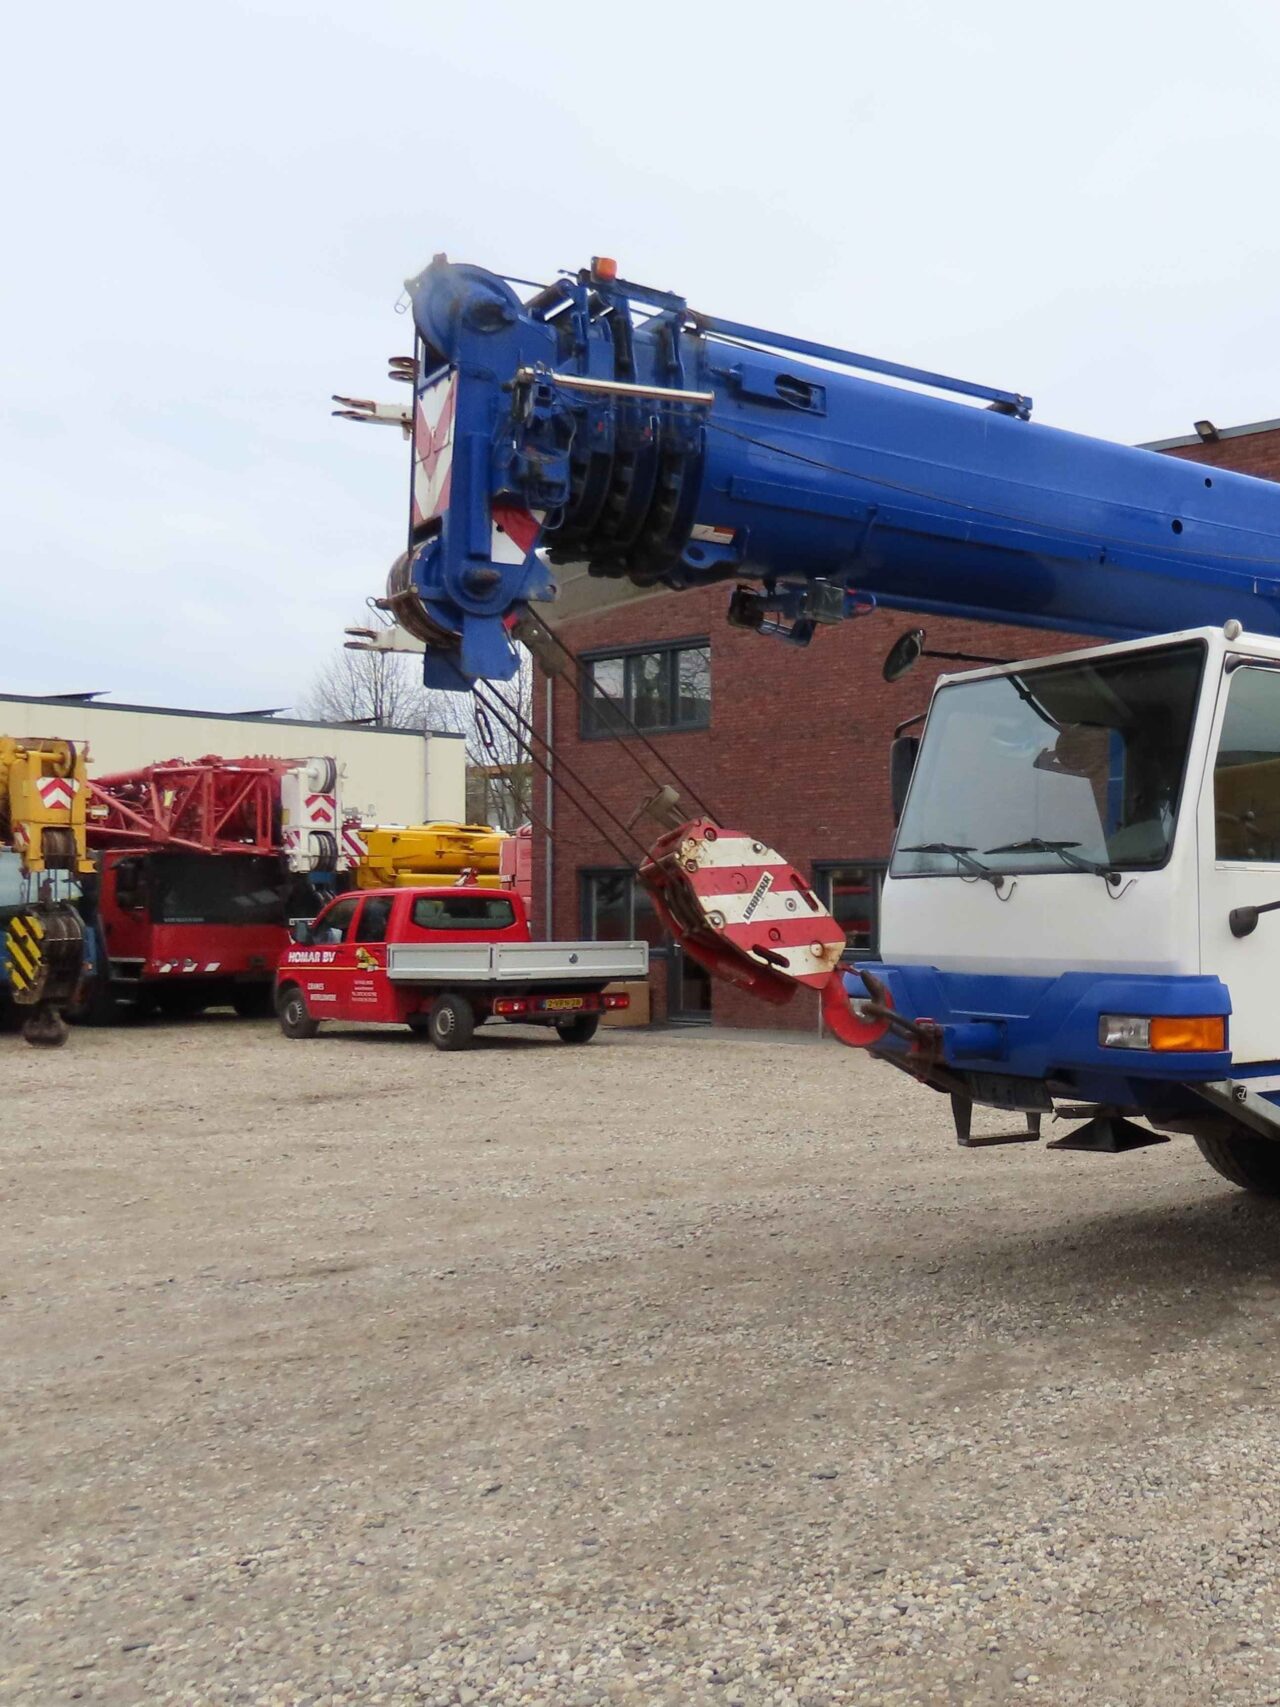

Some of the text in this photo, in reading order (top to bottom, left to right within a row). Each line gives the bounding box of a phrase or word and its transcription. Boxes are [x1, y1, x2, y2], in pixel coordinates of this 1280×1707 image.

[742, 875, 771, 920] LIEBHERR
[288, 951, 336, 963] HOMAR BV
